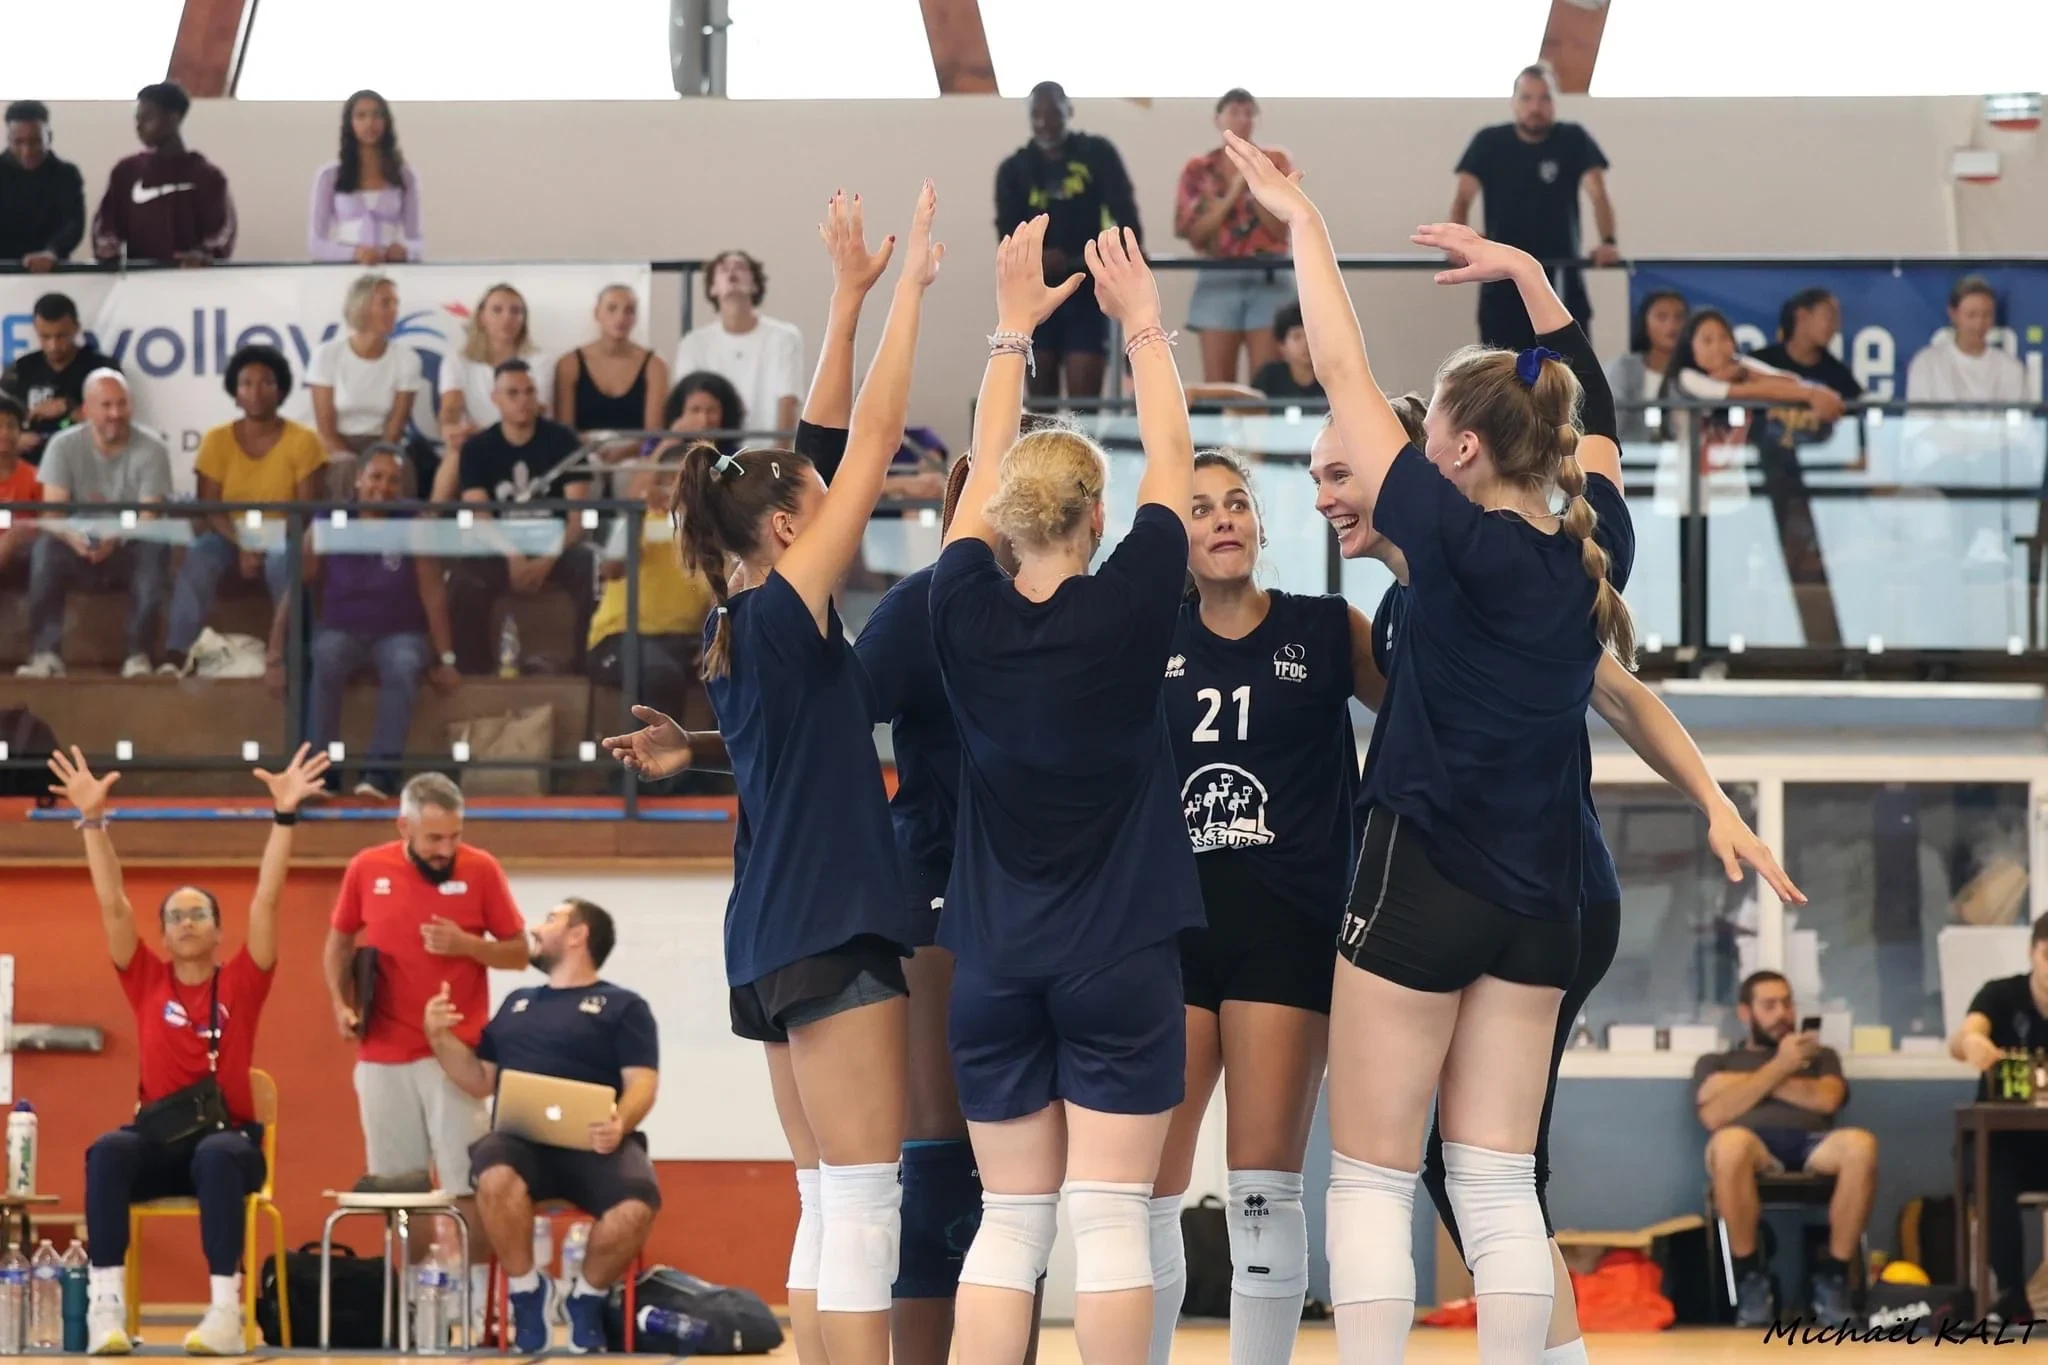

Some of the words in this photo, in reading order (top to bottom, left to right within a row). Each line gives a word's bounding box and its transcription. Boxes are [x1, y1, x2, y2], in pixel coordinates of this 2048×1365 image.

[1164, 668, 1185, 678] rrea
[1273, 660, 1307, 680] TFOC
[1192, 685, 1251, 742] 21
